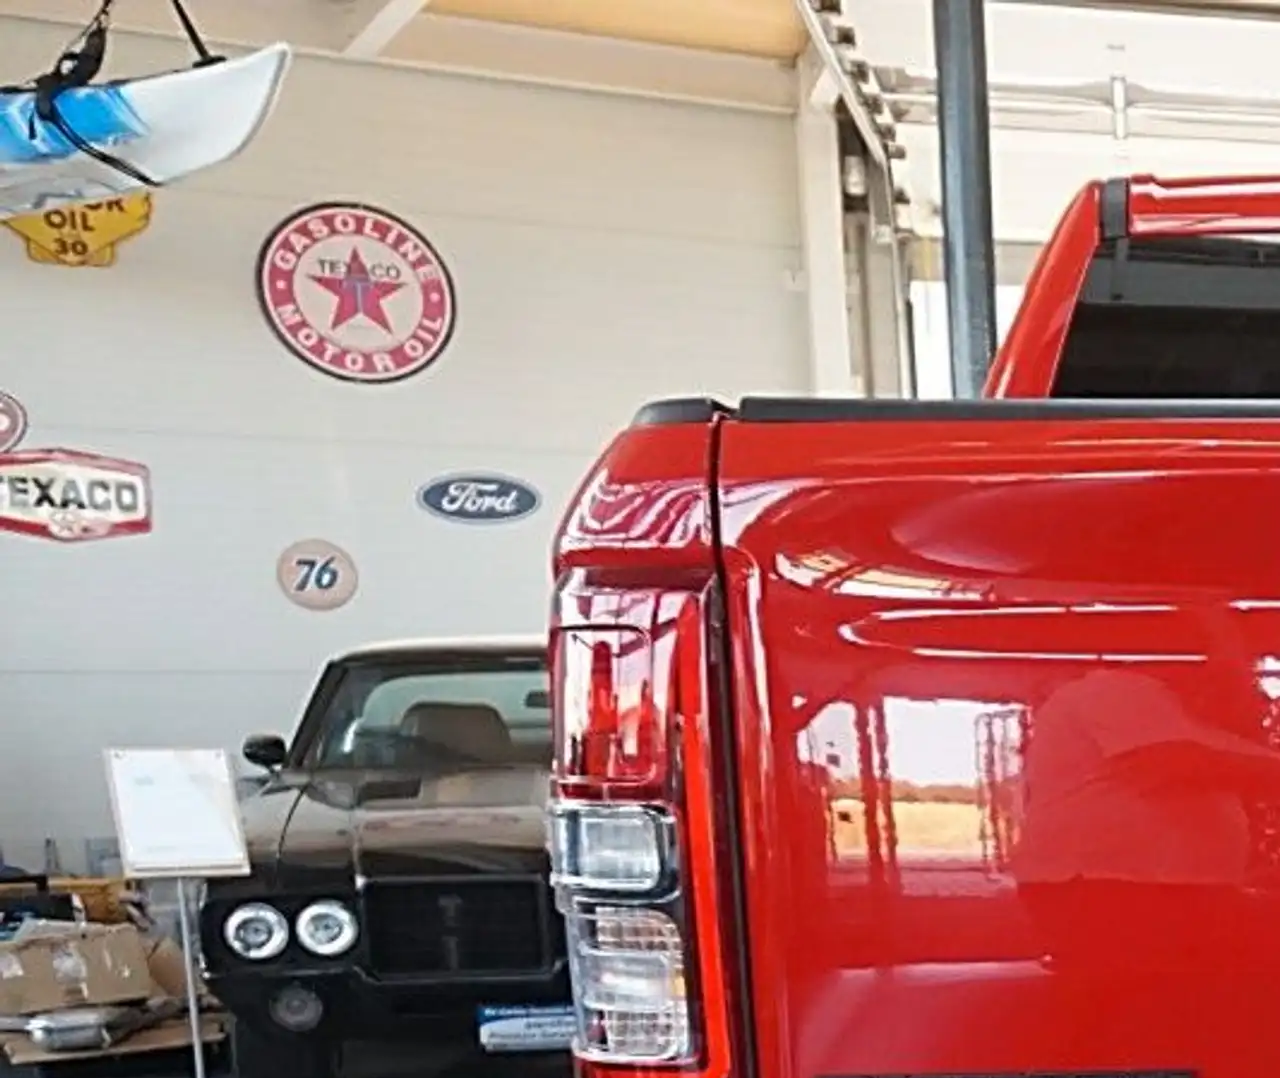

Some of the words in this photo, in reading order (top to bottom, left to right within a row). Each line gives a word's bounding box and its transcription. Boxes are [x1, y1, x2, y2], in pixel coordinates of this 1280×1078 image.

[44, 209, 95, 231] OIL
[53, 238, 88, 255] 30
[274, 214, 440, 282] GASOLINE
[276, 304, 396, 372] MOTOR
[404, 317, 443, 357] OIL
[0, 475, 137, 512] EXACO
[441, 481, 518, 512] Ford
[294, 556, 338, 591] 76
